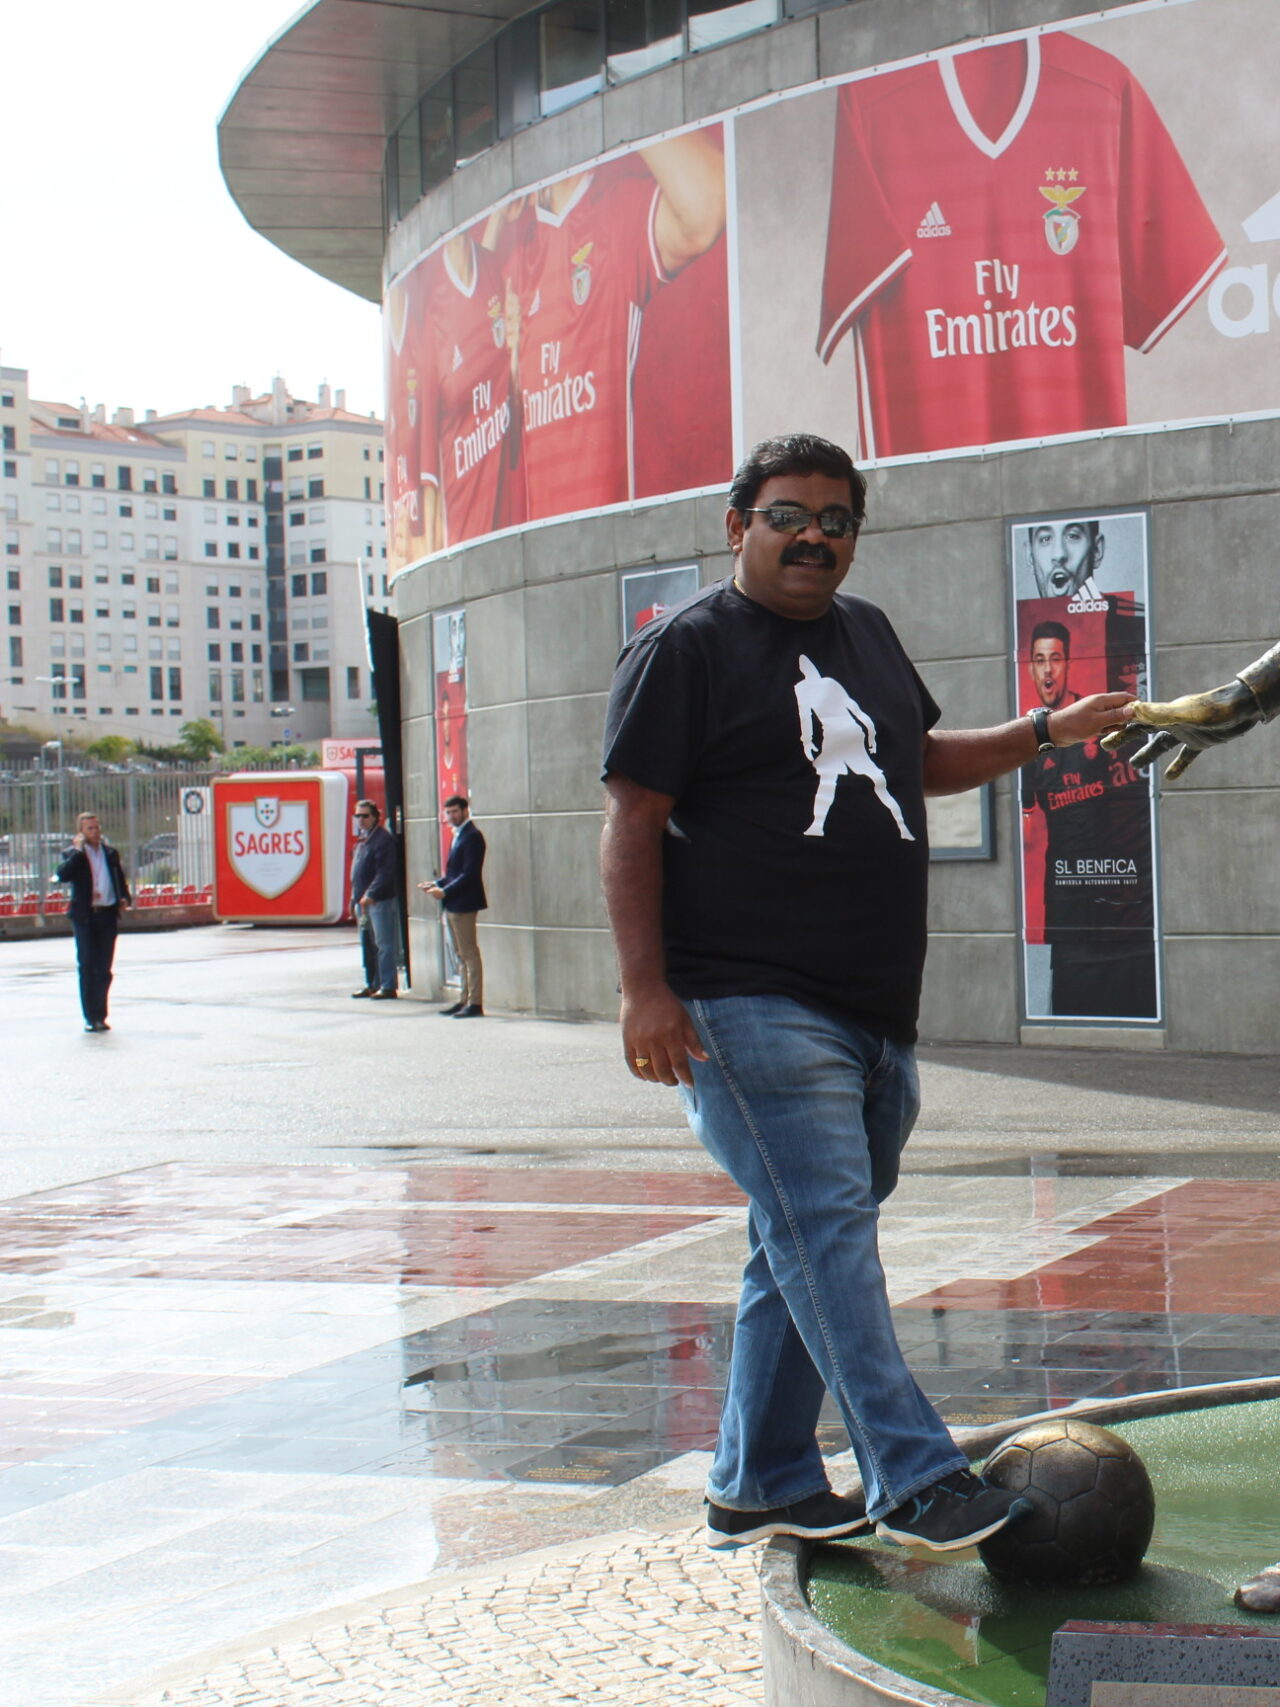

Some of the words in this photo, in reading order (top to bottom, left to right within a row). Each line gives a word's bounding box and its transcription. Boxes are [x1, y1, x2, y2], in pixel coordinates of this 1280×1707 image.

[917, 225, 952, 238] adidas
[974, 258, 1019, 299] Fly
[925, 300, 1077, 358] Emirates
[541, 340, 561, 375] Fly
[472, 379, 491, 416] Fly
[454, 395, 511, 480] Emirate
[1066, 600, 1109, 614] adidas
[1062, 772, 1082, 786] Fly
[1047, 780, 1104, 811] Emirates
[234, 830, 305, 857] SAGRES
[1055, 859, 1072, 875] SL
[1076, 858, 1137, 874] BENFICA
